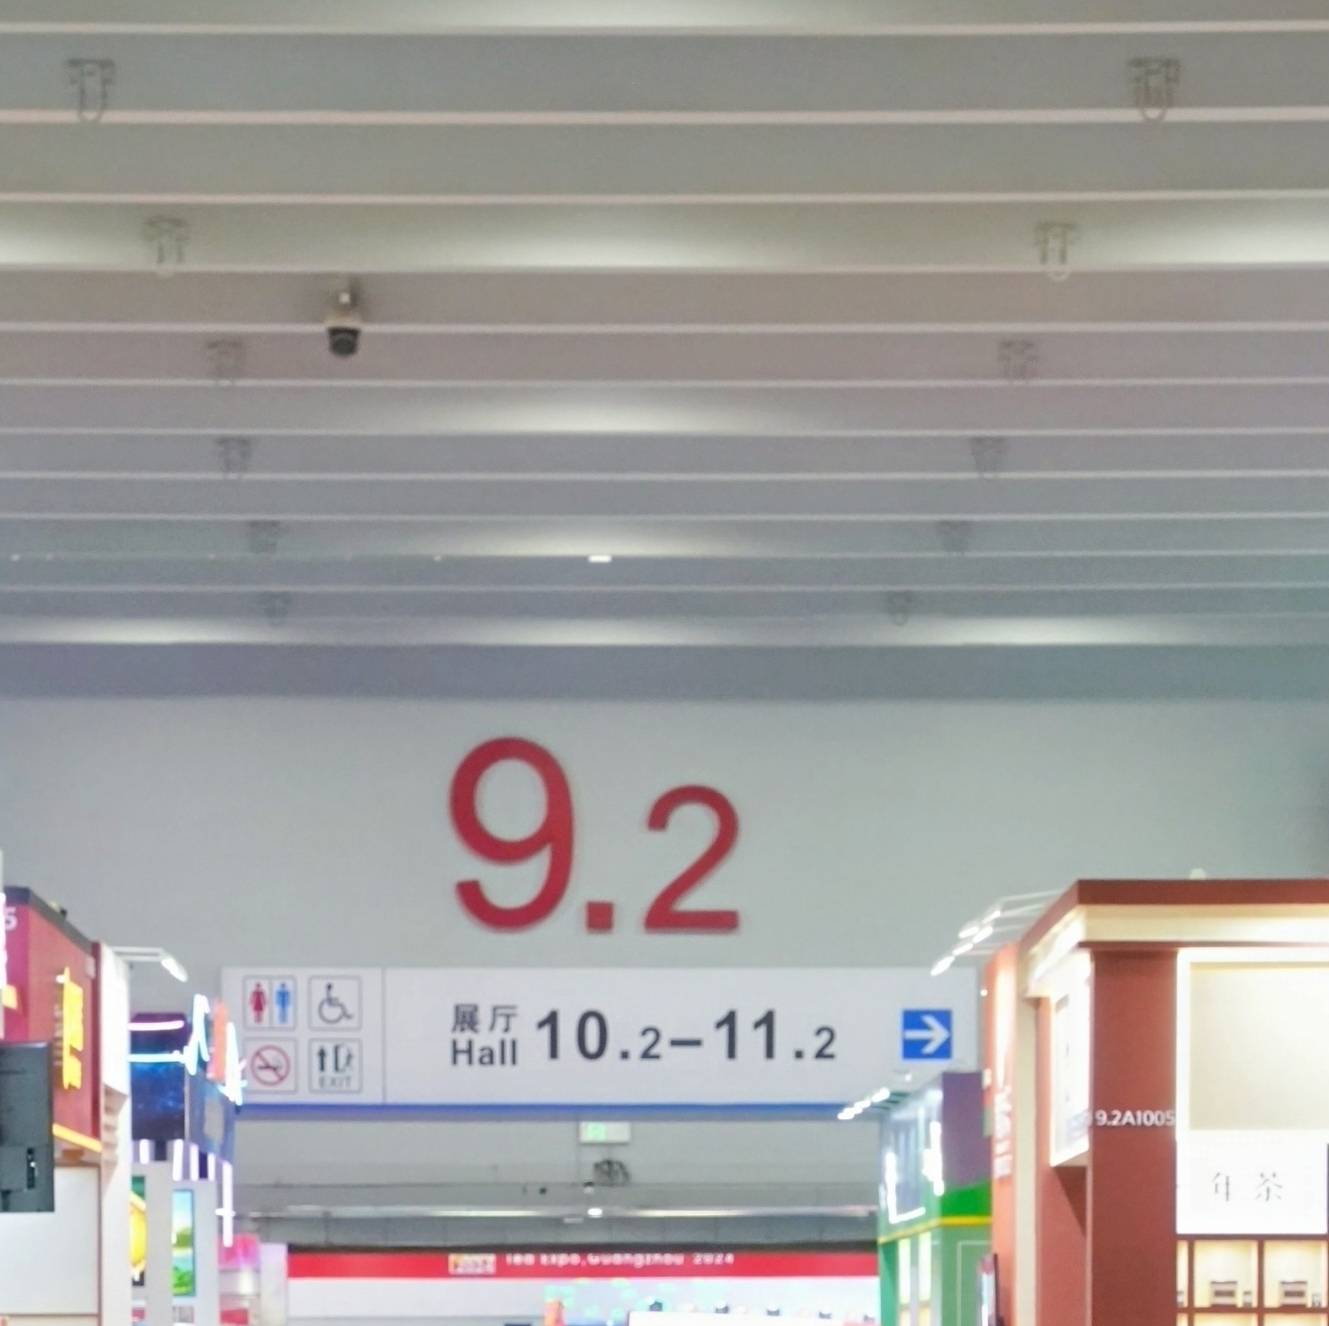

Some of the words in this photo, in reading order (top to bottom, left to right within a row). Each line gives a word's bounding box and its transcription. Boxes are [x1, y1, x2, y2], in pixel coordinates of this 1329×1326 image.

[448, 735, 742, 933] 9.2
[451, 1002, 519, 1033] 展厅
[450, 1037, 519, 1067] Hall
[318, 1075, 352, 1089] EXIT
[1094, 1109, 1176, 1127] 9.2A1005
